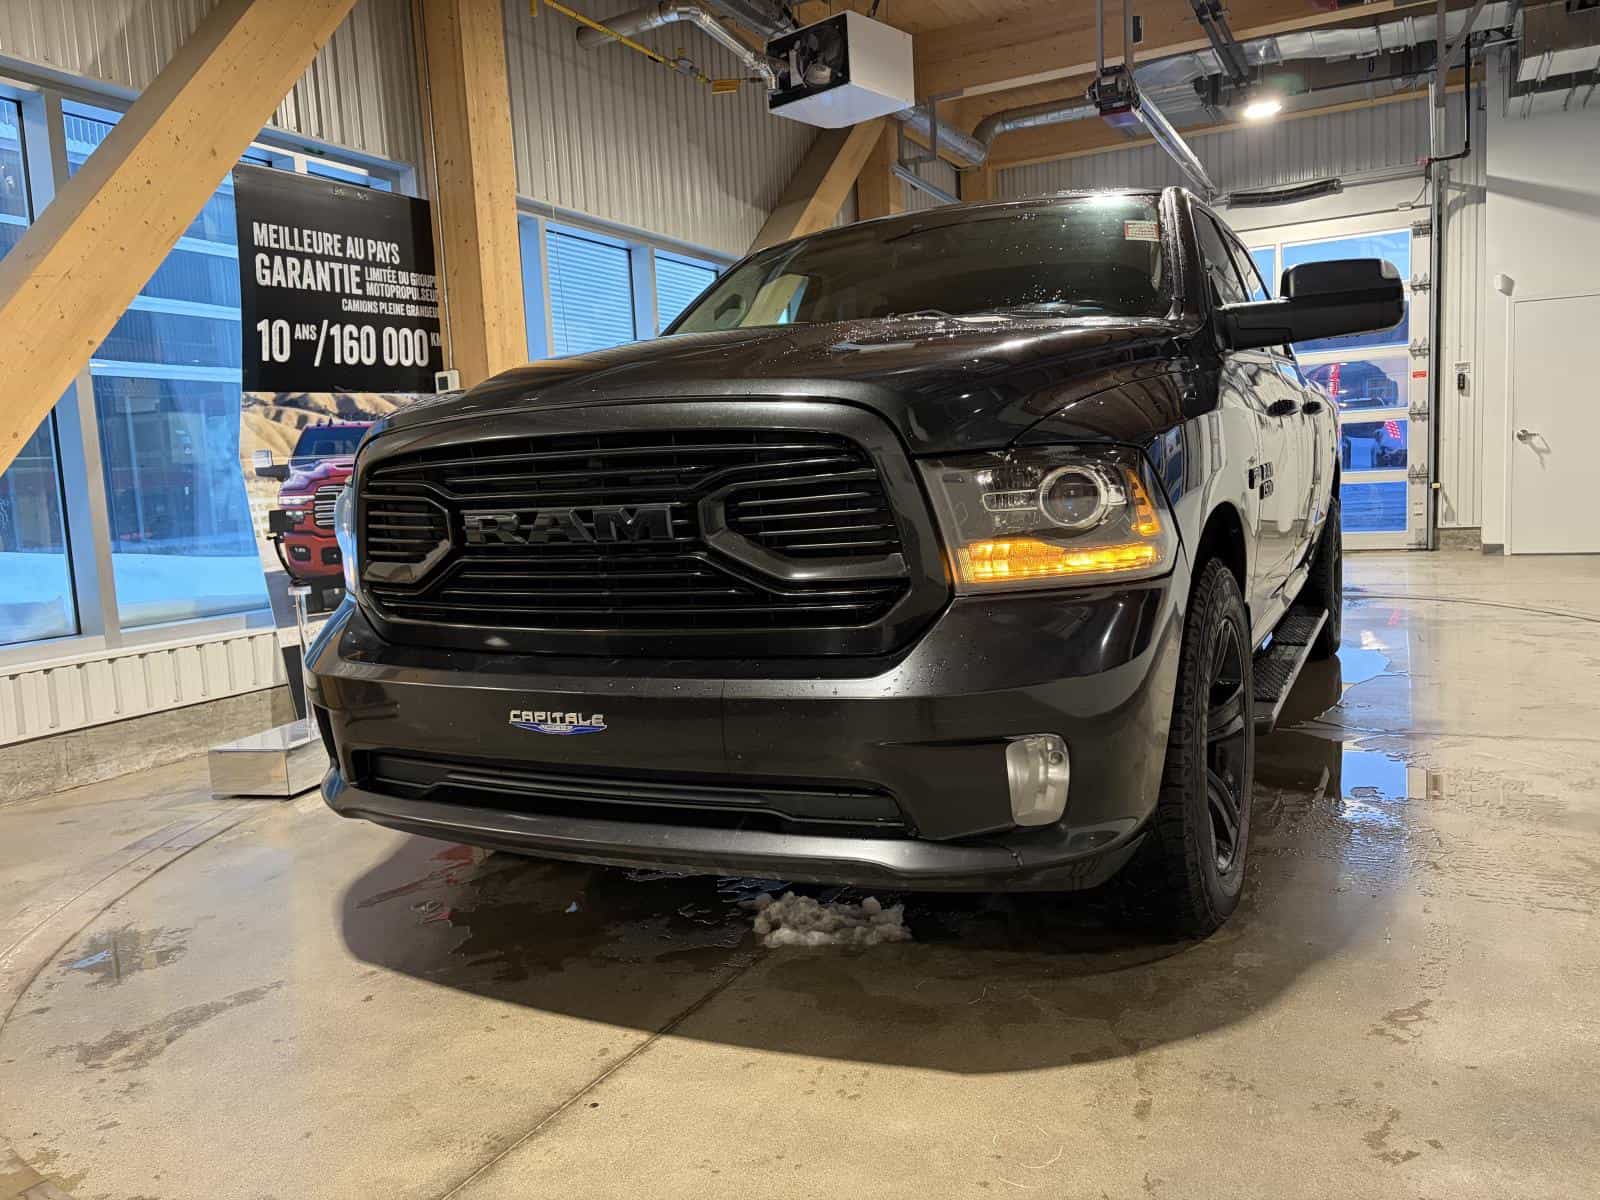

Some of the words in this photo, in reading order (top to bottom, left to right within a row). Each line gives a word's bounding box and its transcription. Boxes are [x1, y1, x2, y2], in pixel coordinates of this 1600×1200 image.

[252, 221, 343, 257] MEILLEURE
[346, 236, 364, 260] AU
[367, 240, 400, 265] PAYS
[255, 252, 362, 295] GARANTIE
[365, 265, 397, 284] LIMITÉE
[398, 271, 409, 285] DU
[342, 298, 378, 314] CAMIONS
[379, 301, 406, 316] PLEINE
[257, 318, 291, 363] 10
[382, 326, 429, 367] 000
[463, 504, 674, 545] RAM
[509, 709, 605, 726] CAPITALE
